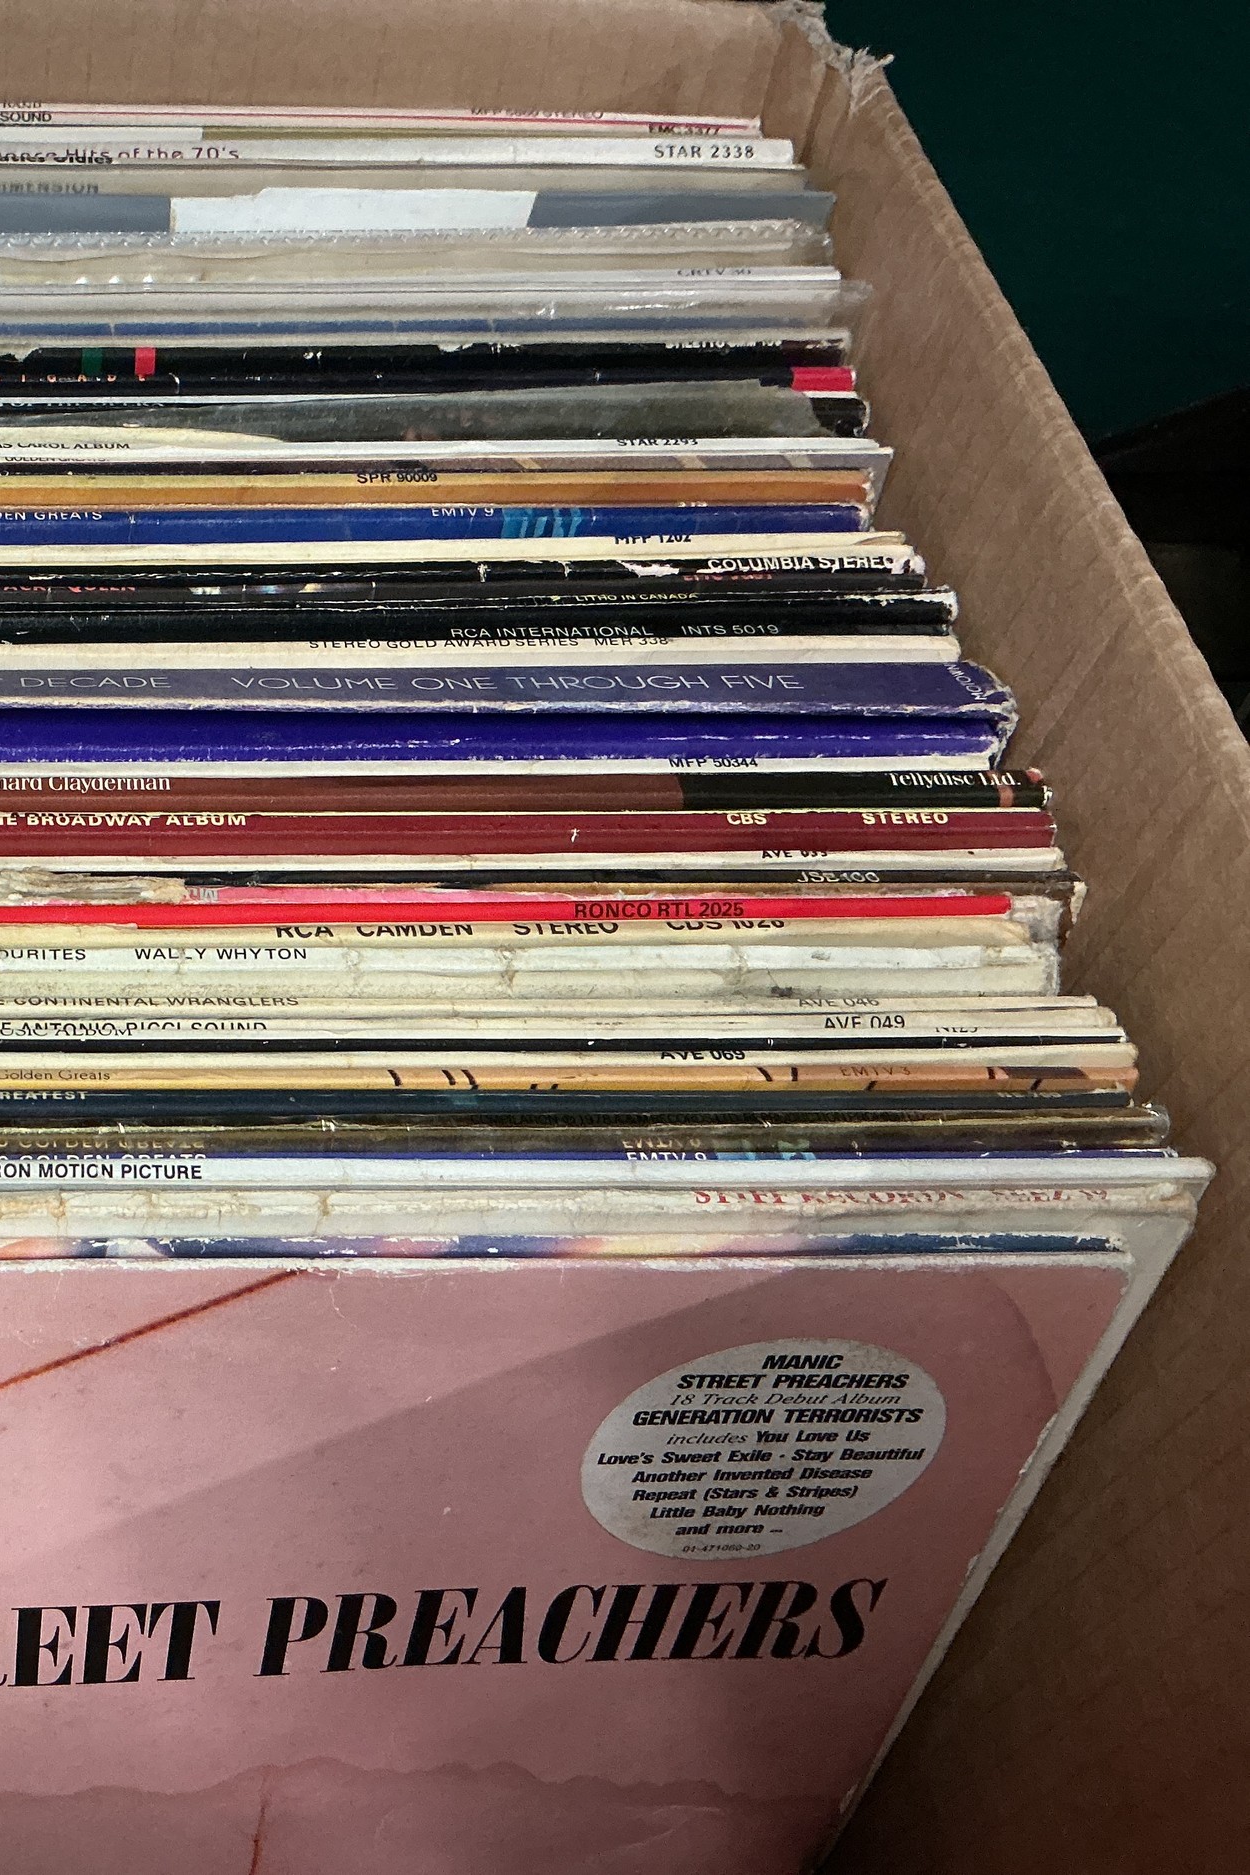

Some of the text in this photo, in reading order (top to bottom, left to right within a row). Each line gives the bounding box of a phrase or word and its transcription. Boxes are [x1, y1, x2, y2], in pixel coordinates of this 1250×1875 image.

[0, 111, 52, 123] SOUND
[147, 148, 184, 159] the
[654, 144, 754, 158] STAR 2338
[356, 472, 438, 485] SPR 90009
[485, 507, 494, 517] 9
[707, 556, 814, 571] COLUMBIA
[638, 592, 699, 601] CANADA
[450, 623, 779, 639] RCA INTERNATIONAL INTS 5019
[19, 676, 172, 689] DECADE
[230, 676, 398, 690] VOLUME
[410, 676, 497, 690] ONE
[505, 674, 710, 691] THROUGH
[720, 674, 805, 690] FIVE
[947, 661, 988, 701] MOTOWN
[669, 757, 758, 769] MFP 50344
[49, 777, 171, 796] Clayderman
[888, 771, 1022, 788] Tellydisc Ltd.
[26, 814, 153, 827] BROADWAY
[164, 813, 248, 827] ALBUM
[726, 811, 949, 826] CBS STEREO
[573, 901, 745, 918] RONCO RTL 2025
[356, 923, 474, 937] CAMDEN
[216, 948, 308, 960] WHYTON
[869, 1015, 906, 1029] 049
[660, 1049, 747, 1061] AVE 069
[57, 1069, 111, 1081] Greats
[38, 1164, 114, 1180] MOTION
[120, 1164, 203, 1180] PICTURE
[761, 1354, 844, 1370] MANIC
[677, 1373, 910, 1390] STREET PREACHERS
[670, 1392, 901, 1406] 18 Track Debut Album
[632, 1408, 924, 1426] GENERATION TERRORISTS
[666, 1430, 871, 1446] includes You Love Us
[597, 1448, 926, 1466] Love's Sweet Exile Stay Beautiful
[632, 1467, 873, 1484] Another Invented Disease
[632, 1485, 859, 1503] Repeat (Stars & Stripes)
[650, 1504, 826, 1520] Little Baby Nothing
[675, 1522, 765, 1536] and more
[254, 1577, 890, 1678] PREACHERS
